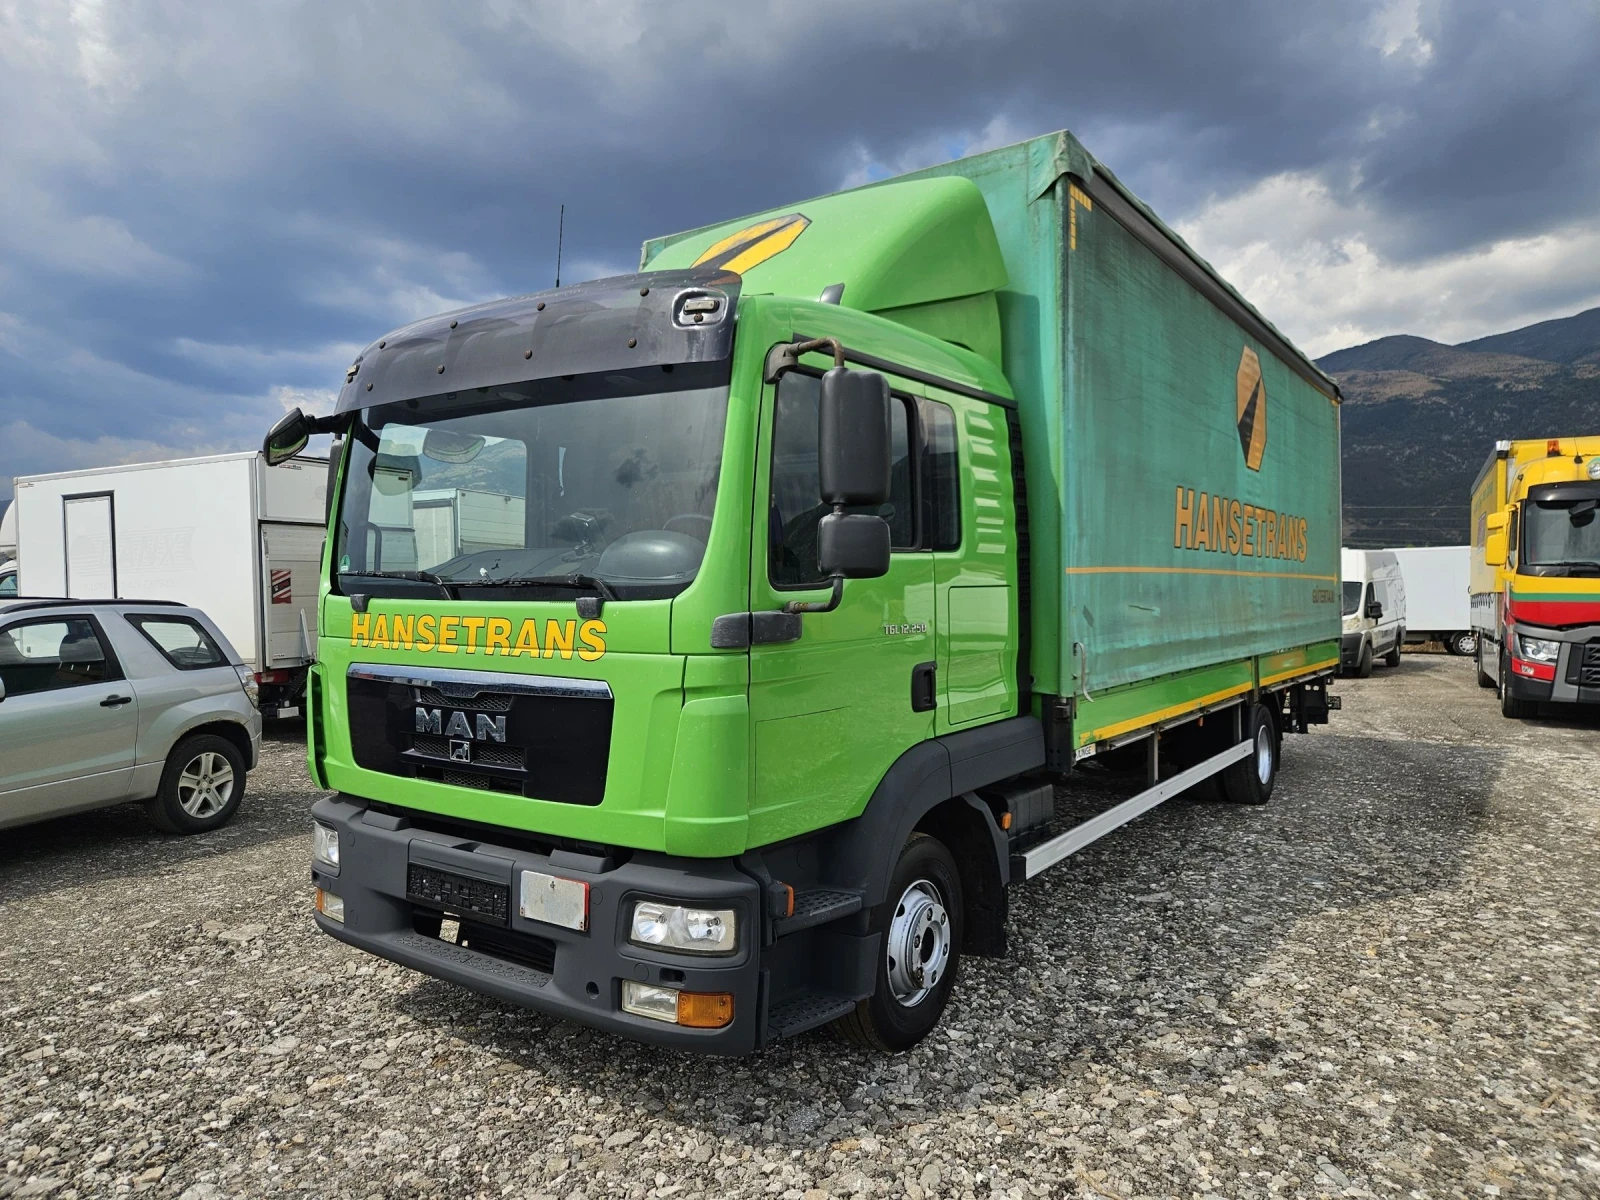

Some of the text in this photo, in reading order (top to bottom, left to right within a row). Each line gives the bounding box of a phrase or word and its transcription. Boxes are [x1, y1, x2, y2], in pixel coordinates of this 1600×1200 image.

[1174, 485, 1307, 563] HANSETRANS
[350, 612, 608, 662] HANSETRANS
[884, 622, 927, 635] TGL 12.250
[415, 706, 507, 743] MAN
